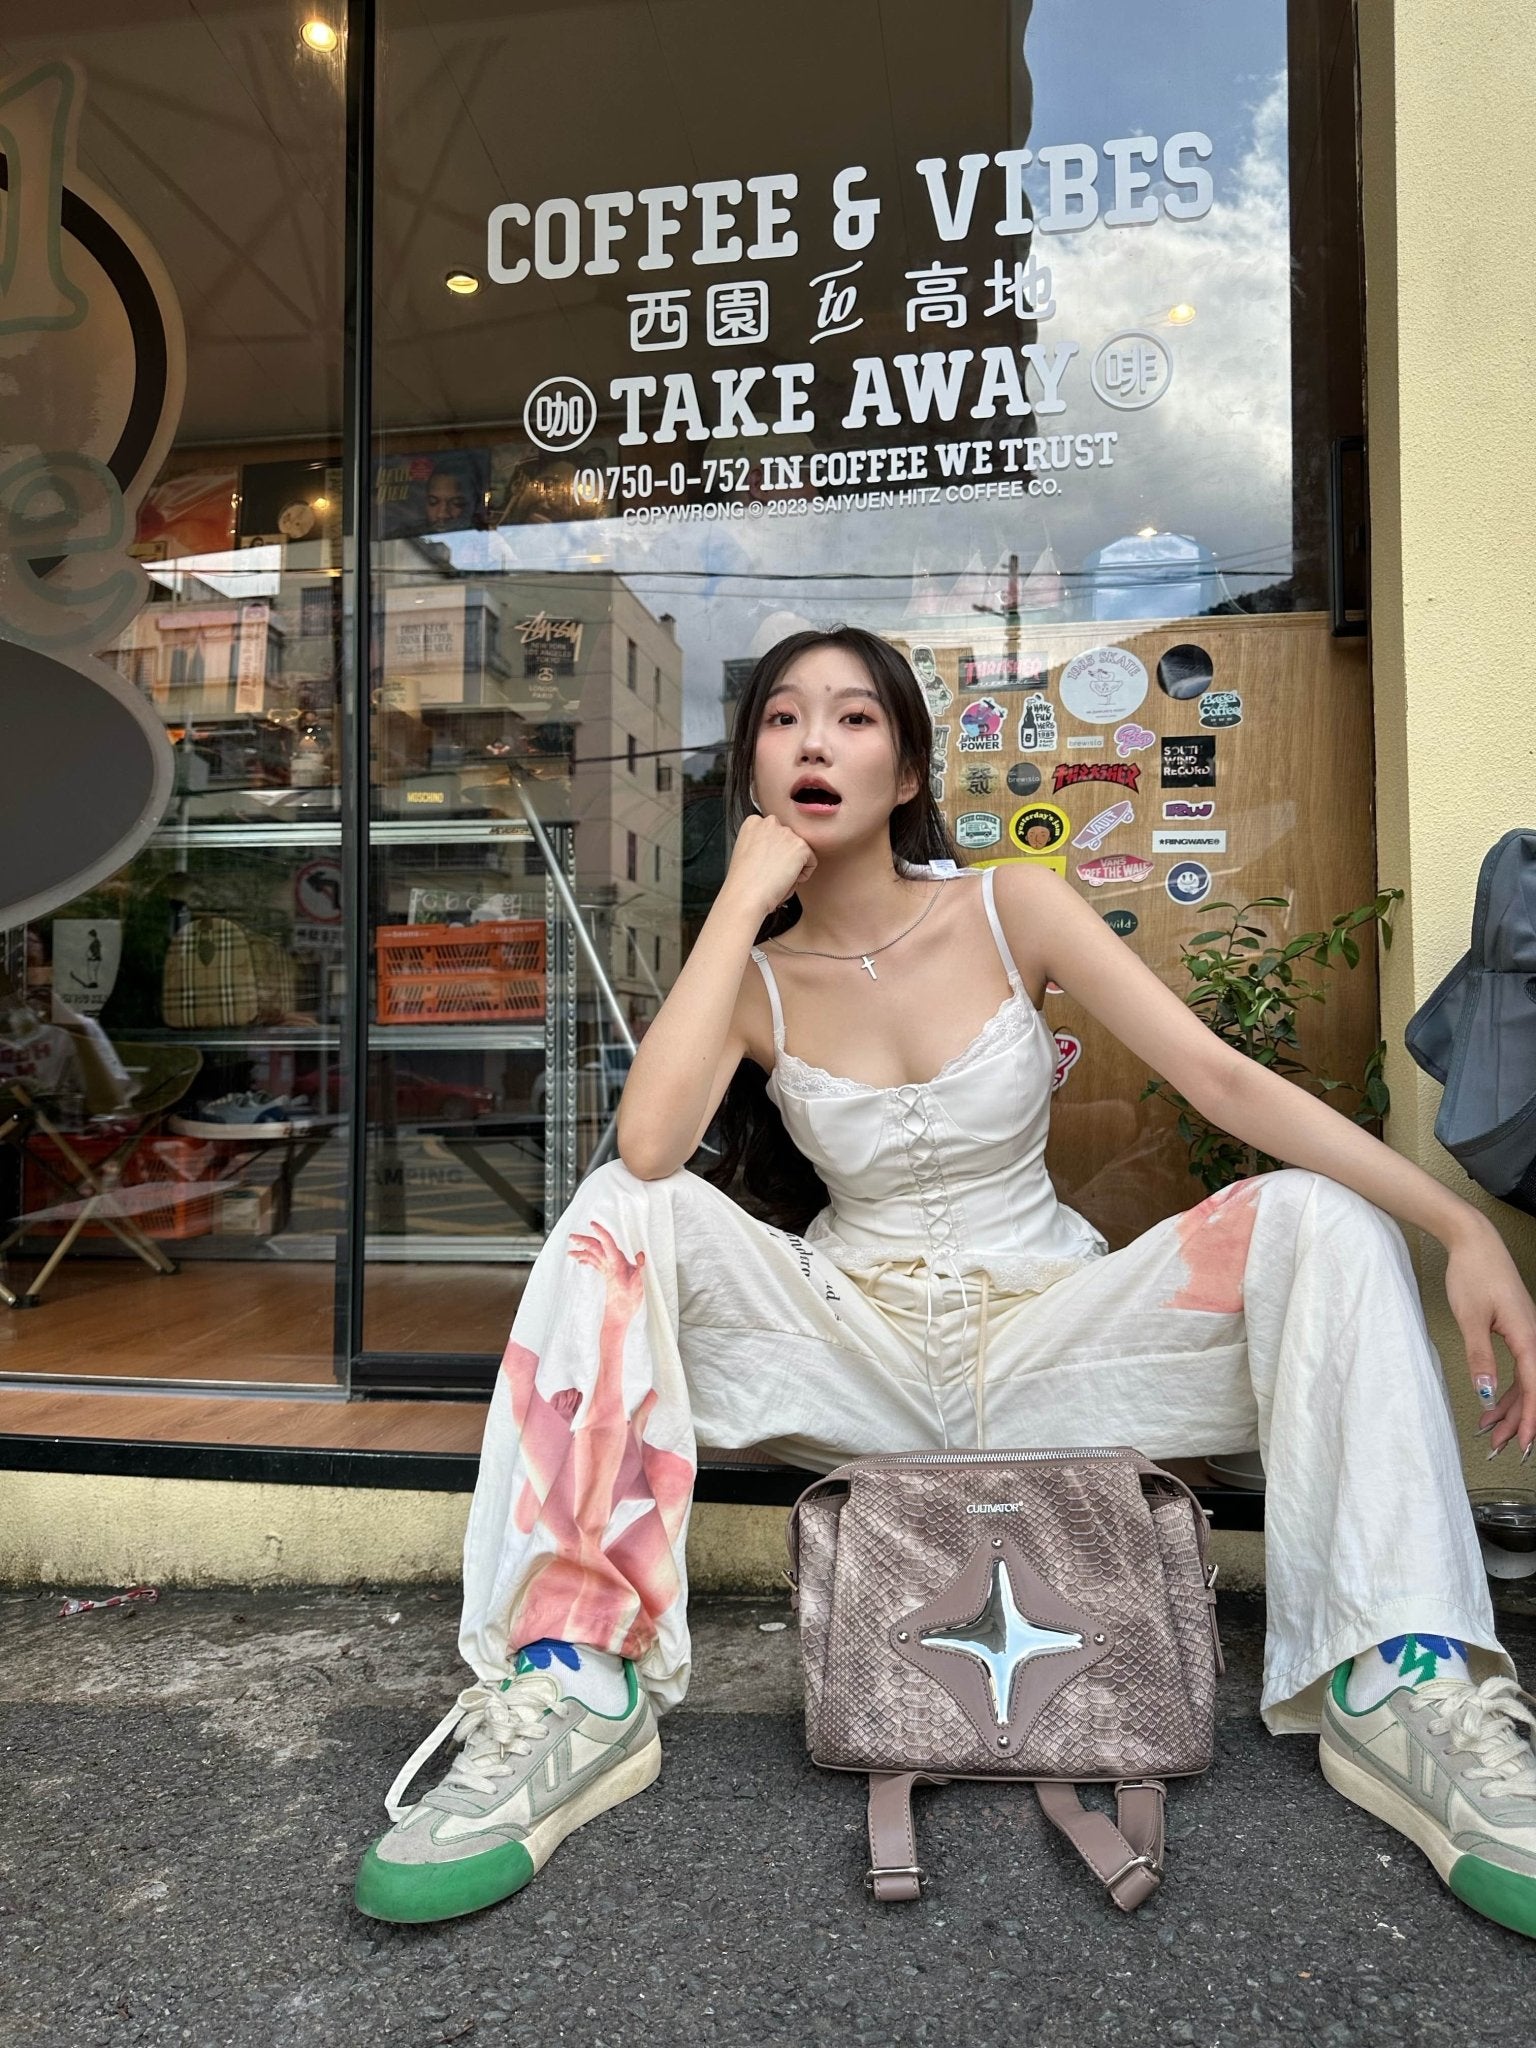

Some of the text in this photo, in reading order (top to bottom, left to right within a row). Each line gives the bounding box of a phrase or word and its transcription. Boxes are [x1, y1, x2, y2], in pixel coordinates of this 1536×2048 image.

[488, 131, 1214, 284] COFFEE & VIBES
[812, 268, 860, 337] to
[904, 254, 1056, 333] 高地
[626, 279, 769, 353] 西園
[1098, 337, 1165, 403] 啡
[609, 341, 1080, 446] TAKE AWAY
[530, 384, 590, 445] 咖
[573, 431, 1119, 506] (0)750-0-752 IN COFFEE WE TRUST
[622, 501, 745, 525] COPYWRONG
[767, 498, 808, 517] 2023
[812, 490, 894, 513] SAIYUEN
[899, 486, 941, 506] HITZ
[945, 481, 1024, 501] COFFEE
[1029, 478, 1062, 497] CO.
[1098, 651, 1141, 677] SKATE
[1033, 703, 1052, 714] HAVE
[1203, 691, 1238, 705] Bagel
[1036, 713, 1053, 722] FUN
[1201, 706, 1241, 717] Coffee
[960, 741, 1000, 751] POWER
[961, 733, 999, 742] UNITED
[1163, 755, 1197, 766] WIND
[1052, 763, 1141, 794] THRASHER
[1018, 811, 1053, 836] yesterday's
[1086, 810, 1118, 836] VAULT
[1100, 857, 1127, 867] VANS
[1102, 866, 1123, 879] THE
